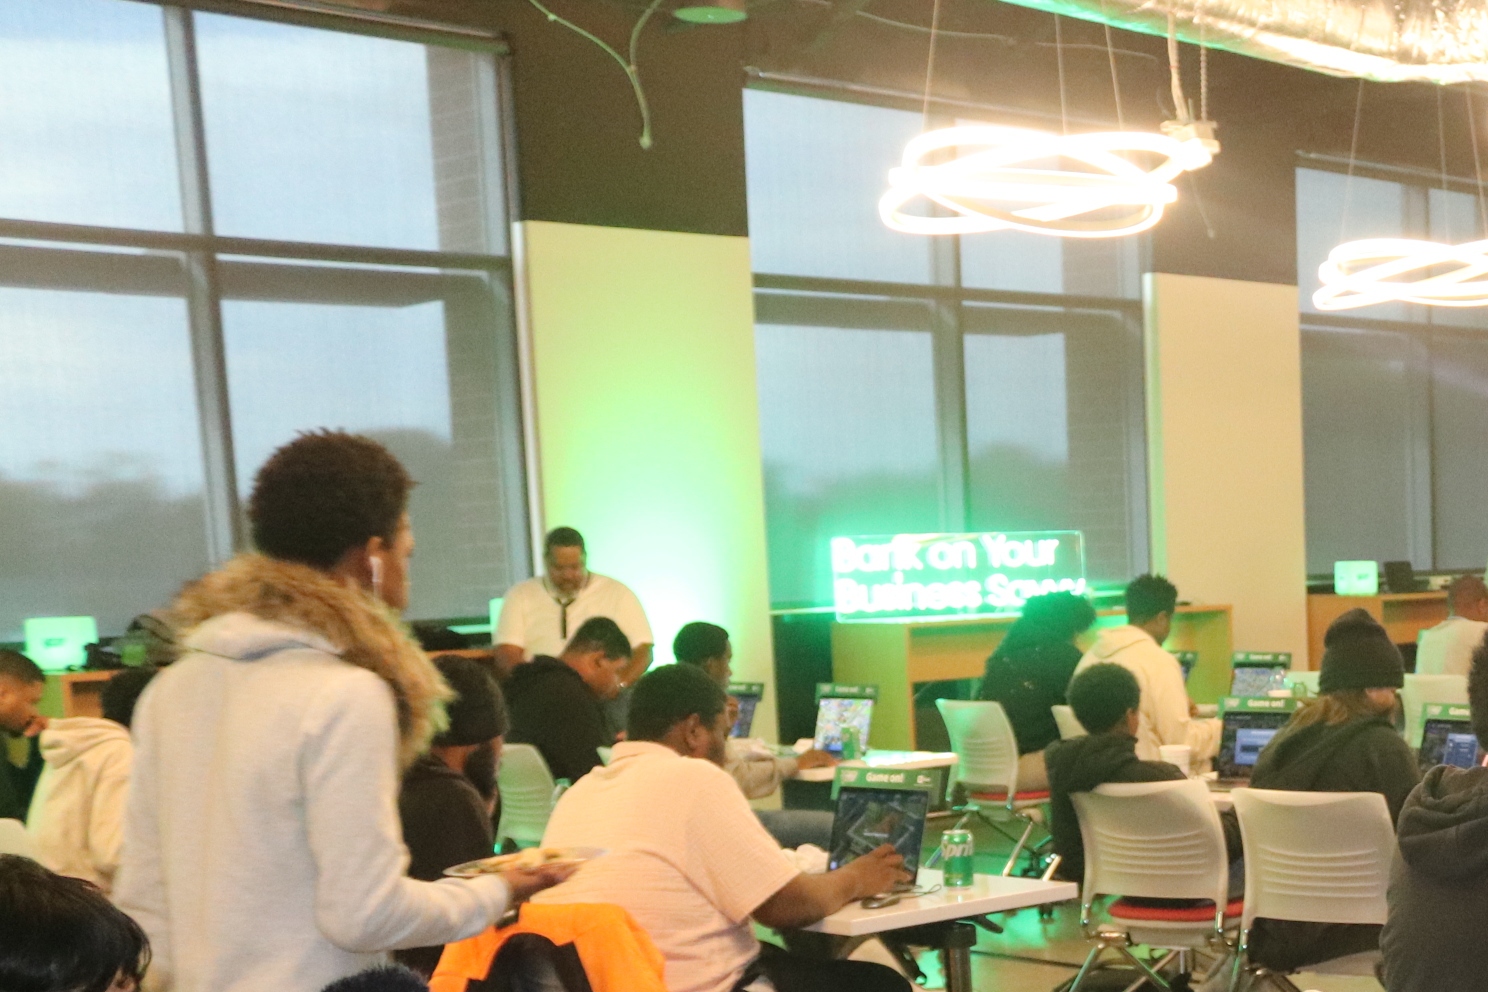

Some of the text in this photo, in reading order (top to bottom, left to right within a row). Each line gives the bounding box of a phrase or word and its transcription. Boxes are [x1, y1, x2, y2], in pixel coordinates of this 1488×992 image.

[834, 534, 1059, 572] Bank on Your
[836, 572, 983, 614] Business
[866, 772, 889, 783] Game
